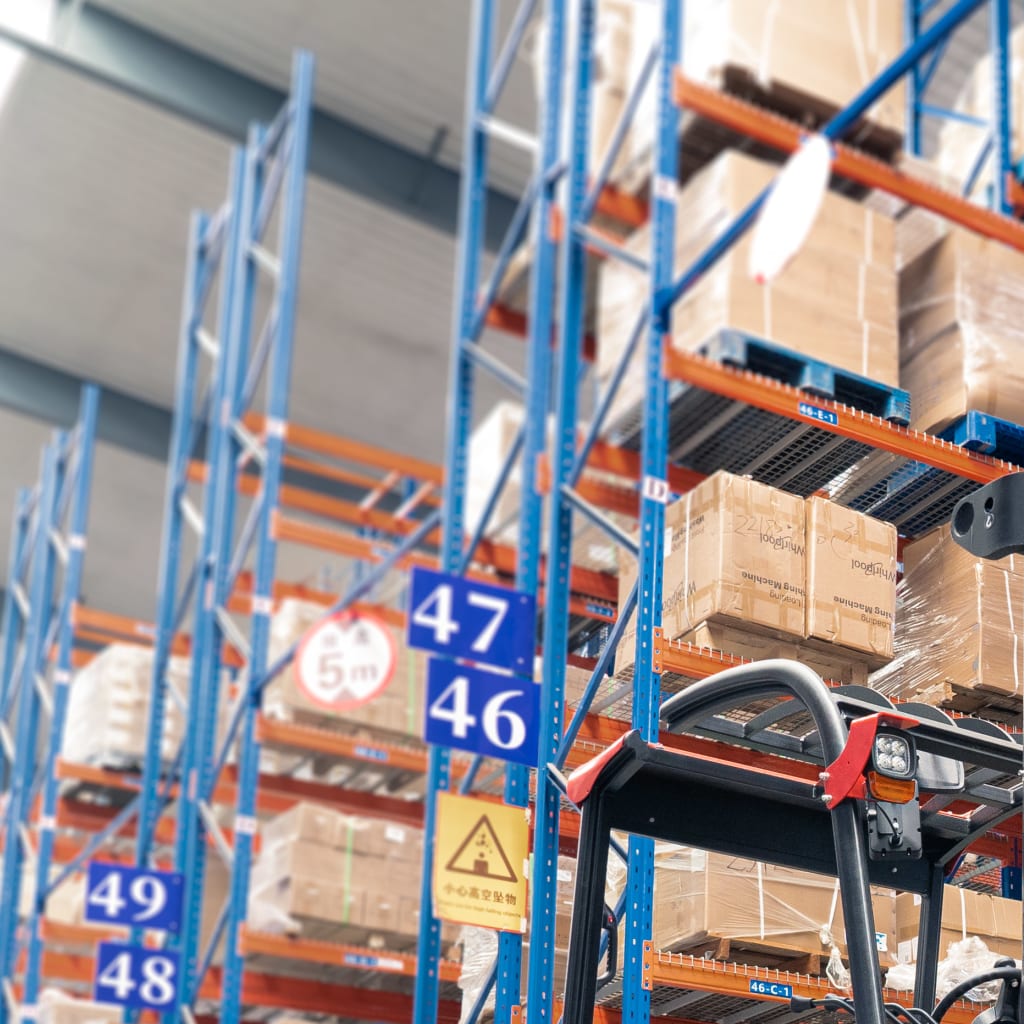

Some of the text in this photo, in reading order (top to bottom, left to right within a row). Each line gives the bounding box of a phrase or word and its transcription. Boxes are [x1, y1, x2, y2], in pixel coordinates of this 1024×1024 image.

[741, 571, 783, 591] Machine
[833, 595, 873, 615] Machine
[413, 584, 509, 653] 47
[429, 677, 526, 750] 46
[89, 871, 168, 922] 49
[98, 952, 176, 1005] 48
[751, 982, 790, 997] 46-C-1
